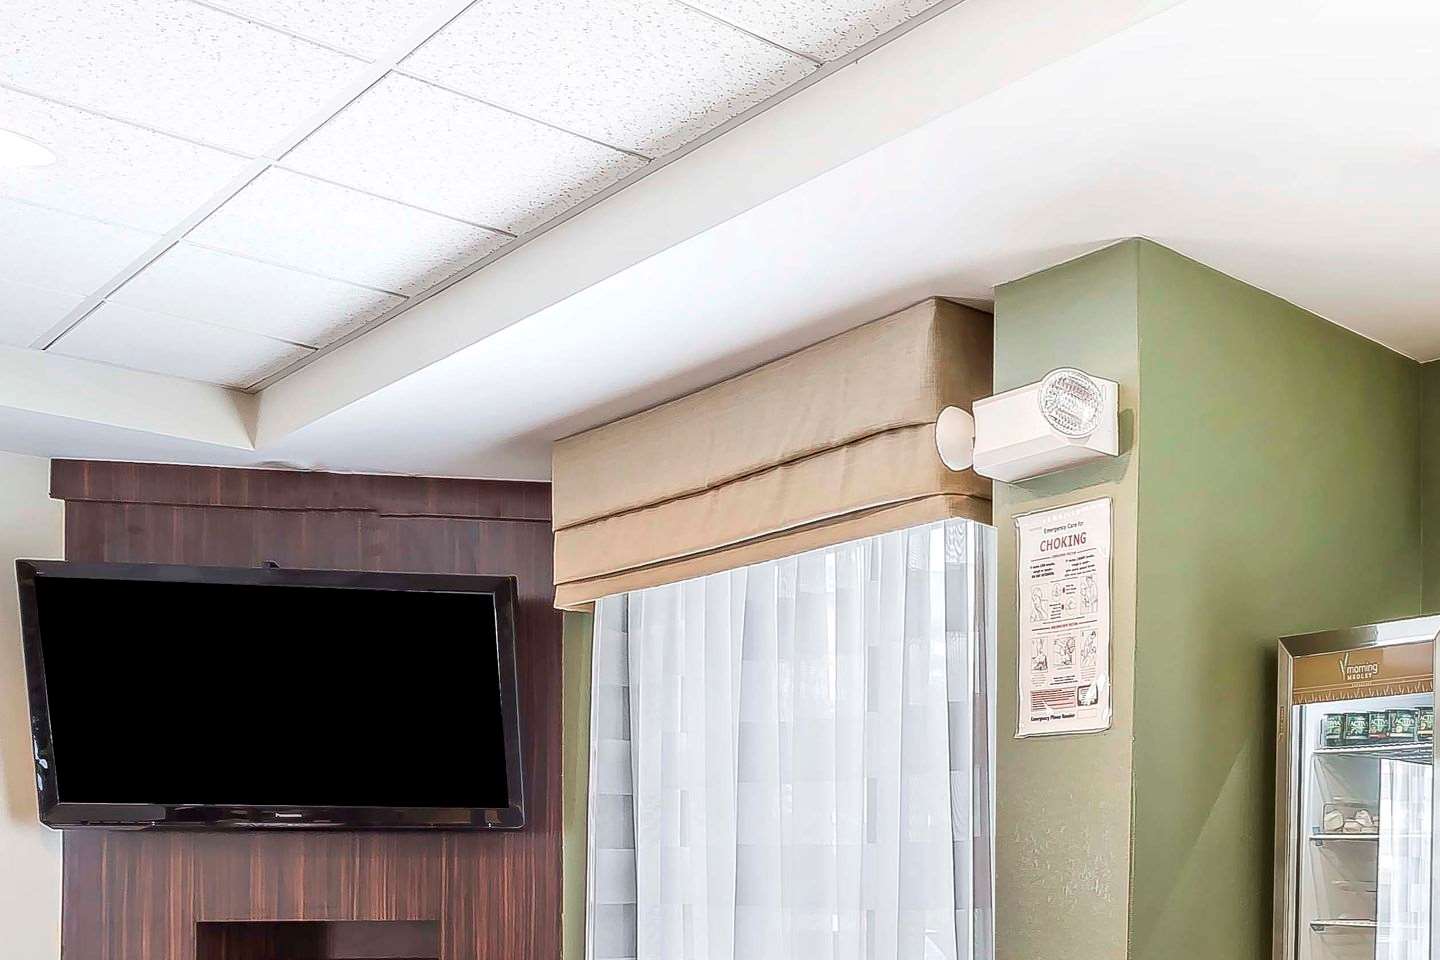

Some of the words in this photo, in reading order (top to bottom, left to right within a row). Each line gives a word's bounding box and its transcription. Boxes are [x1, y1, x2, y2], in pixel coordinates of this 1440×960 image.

[1043, 525, 1067, 534] Emergency
[1040, 531, 1087, 552] CHOKING
[1347, 662, 1378, 674] morning
